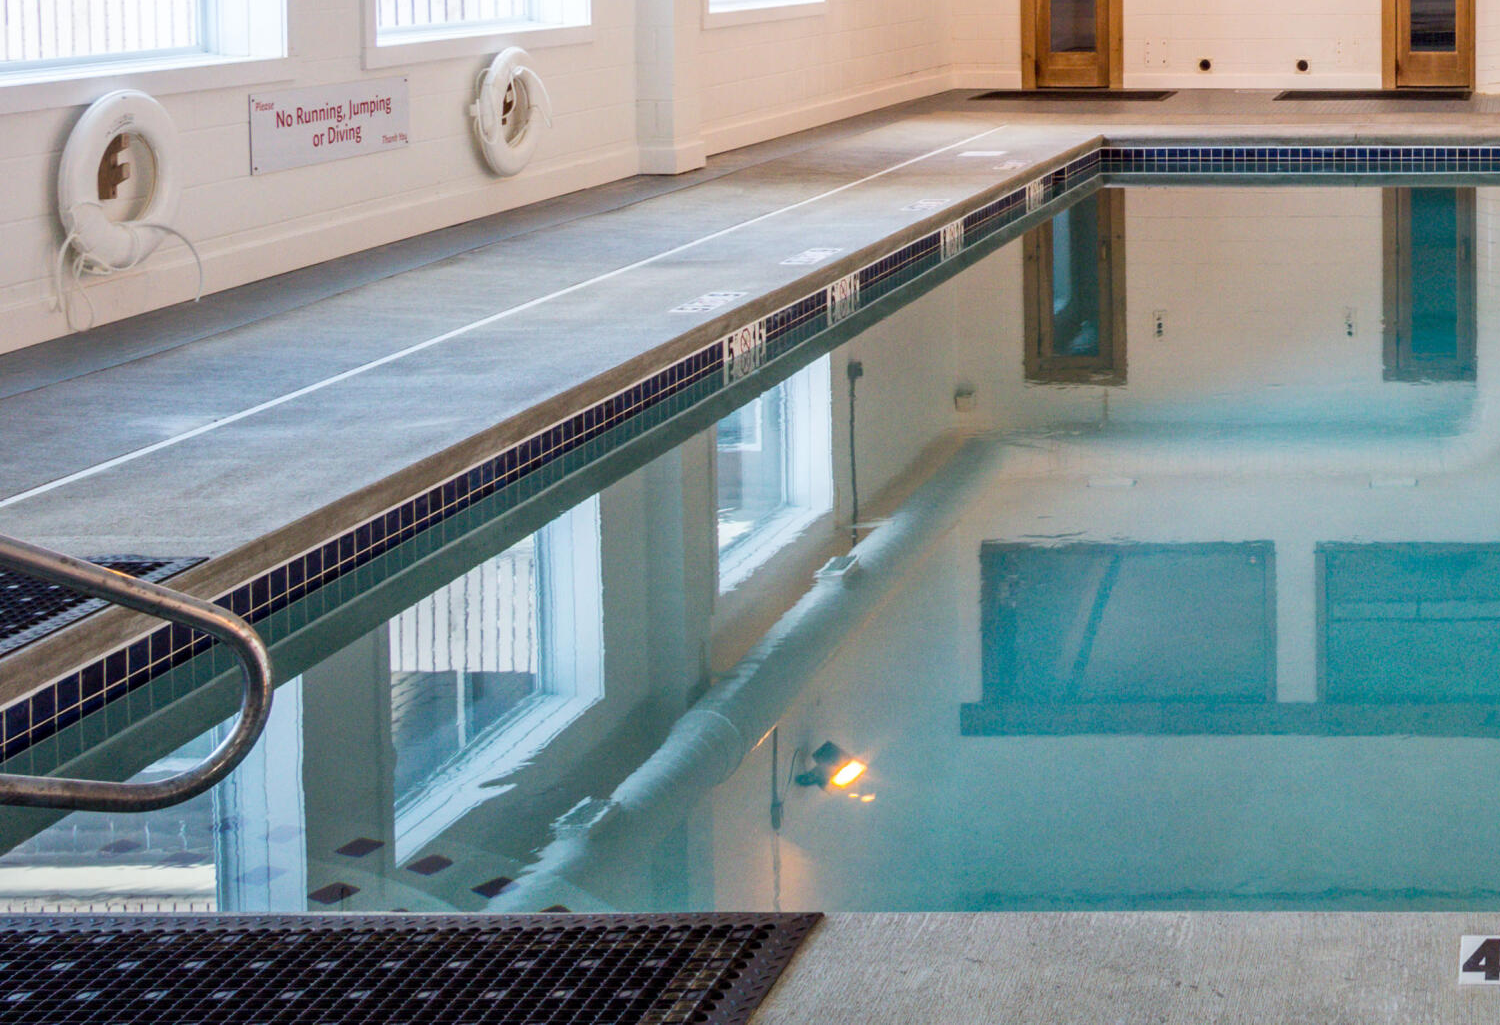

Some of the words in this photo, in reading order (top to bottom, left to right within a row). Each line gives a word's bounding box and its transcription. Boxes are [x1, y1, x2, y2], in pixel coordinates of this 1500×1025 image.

[255, 101, 275, 112] Please
[275, 110, 293, 129] No
[296, 102, 346, 125] Running,
[349, 94, 392, 120] Jumping
[312, 132, 326, 148] or
[327, 123, 362, 145] Diving
